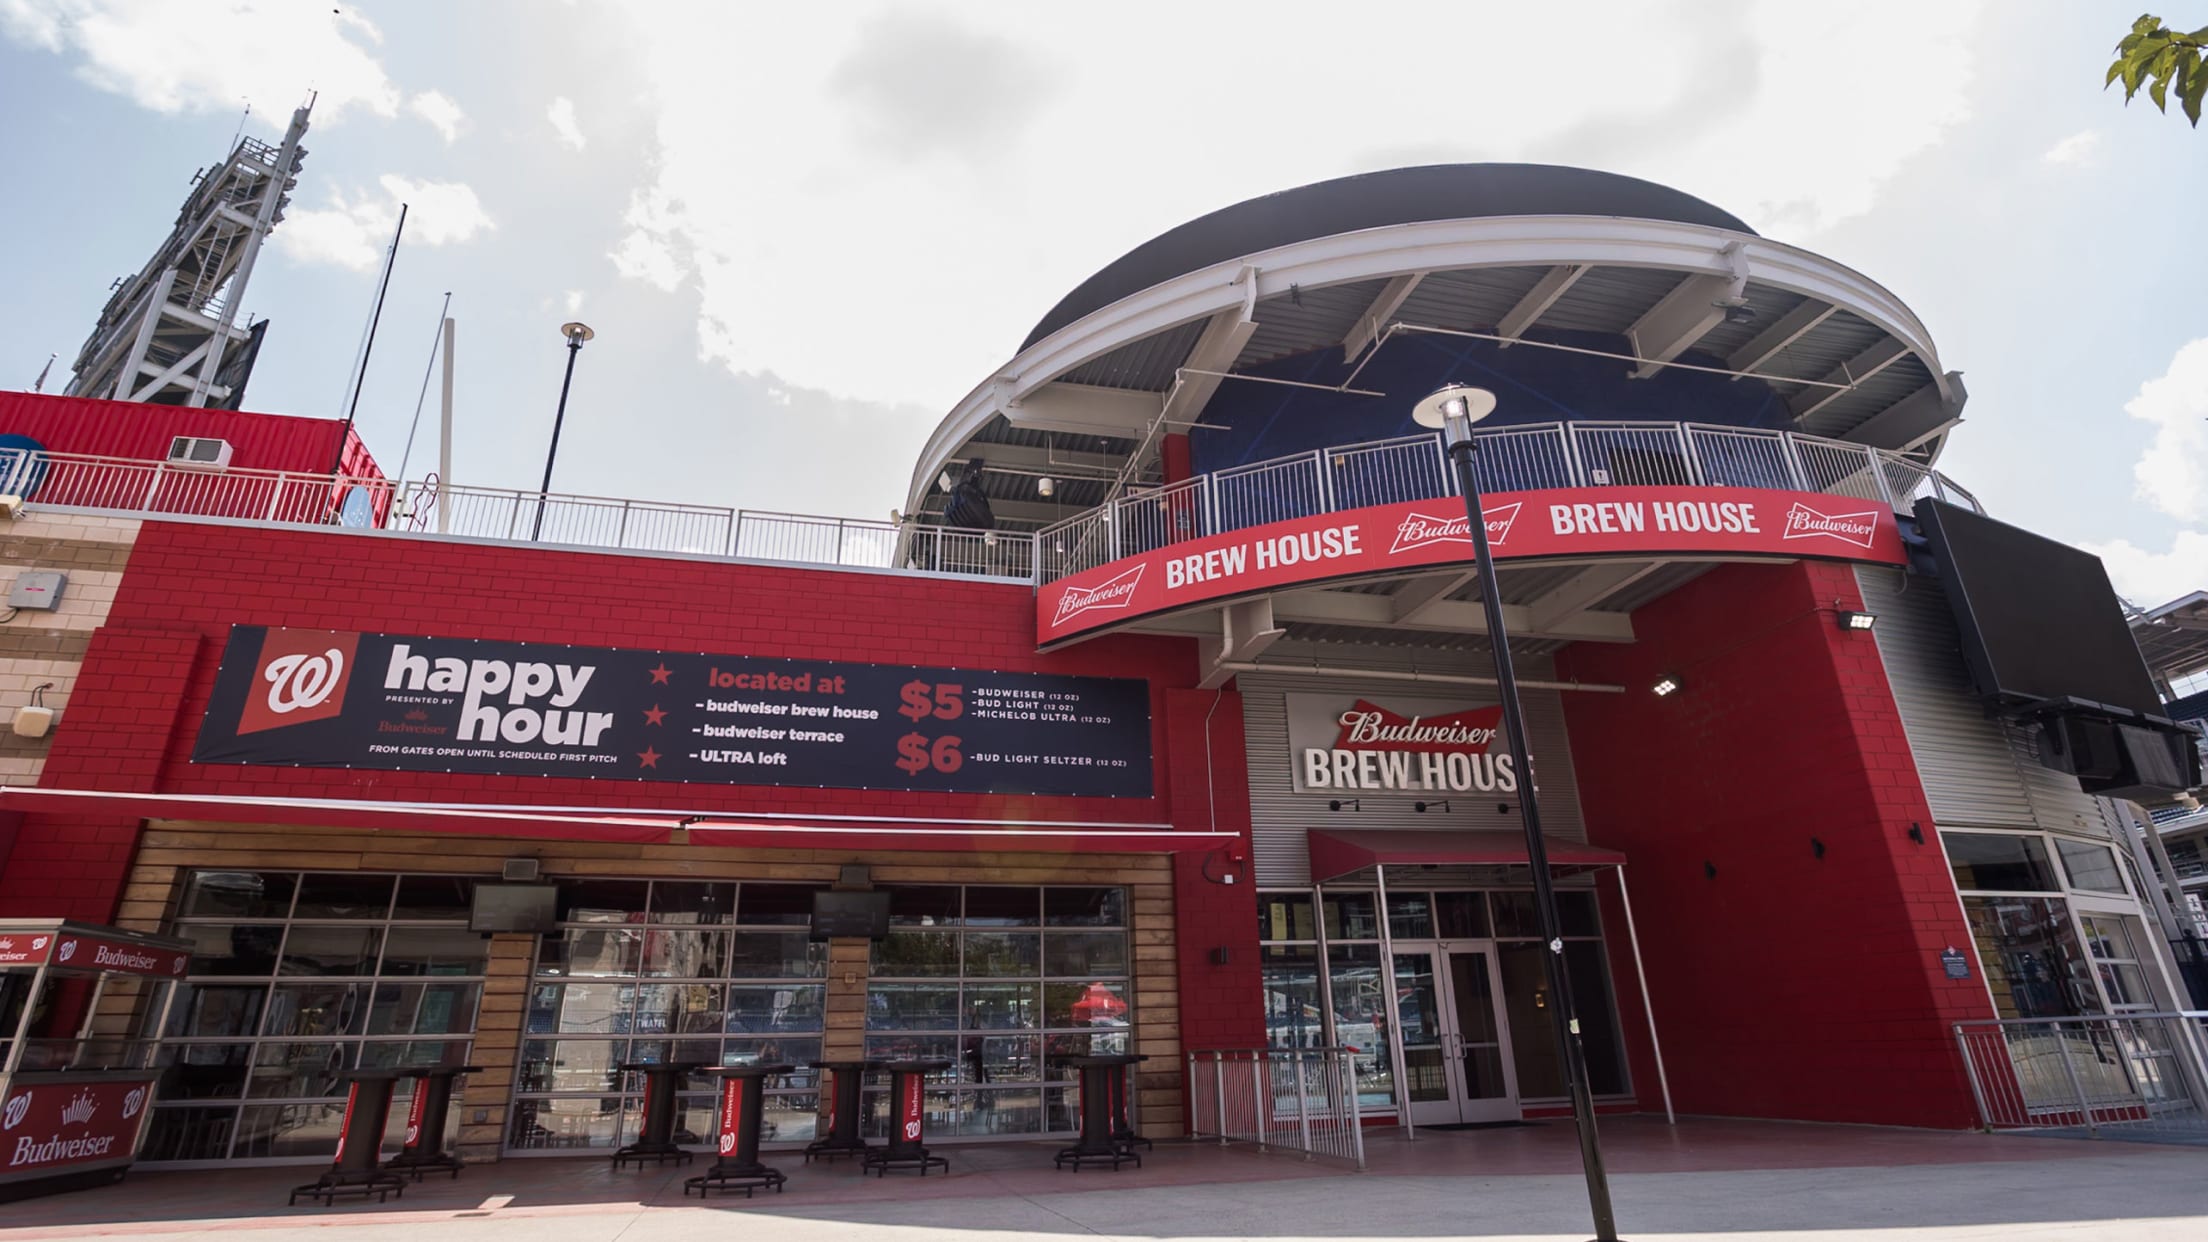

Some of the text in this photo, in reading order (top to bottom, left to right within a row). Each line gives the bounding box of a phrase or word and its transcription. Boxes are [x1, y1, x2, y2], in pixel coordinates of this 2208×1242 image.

[1549, 500, 1761, 536] BREW HOUSE
[1786, 510, 1873, 535] Budweiser
[1166, 524, 1363, 590] BREW HOUSE
[1059, 581, 1135, 615] Budweiser
[384, 644, 597, 708] happy
[708, 667, 846, 695] located at
[385, 695, 454, 706] PRESENTED BY
[791, 703, 830, 718] brew
[832, 706, 880, 720] house
[897, 679, 964, 723] $5
[1006, 701, 1039, 710] LIGHT
[377, 720, 448, 735] Budweiser
[456, 700, 614, 747] hour
[1041, 713, 1077, 723] ULTRA
[1338, 711, 1497, 746] Budweiser
[789, 728, 845, 743] terrace
[369, 744, 618, 765] FROM GATES OPEN UNTIL SCHEDULED FIRST PITCH
[758, 752, 788, 766] loft
[895, 731, 963, 777] $6
[1004, 755, 1040, 764] LIGHT
[1043, 757, 1093, 766] SELTZER
[1304, 748, 1411, 790] BREW
[94, 945, 157, 970] Budweiser
[724, 1079, 736, 1129] Budweiser
[9, 1131, 115, 1167] Budweiser
